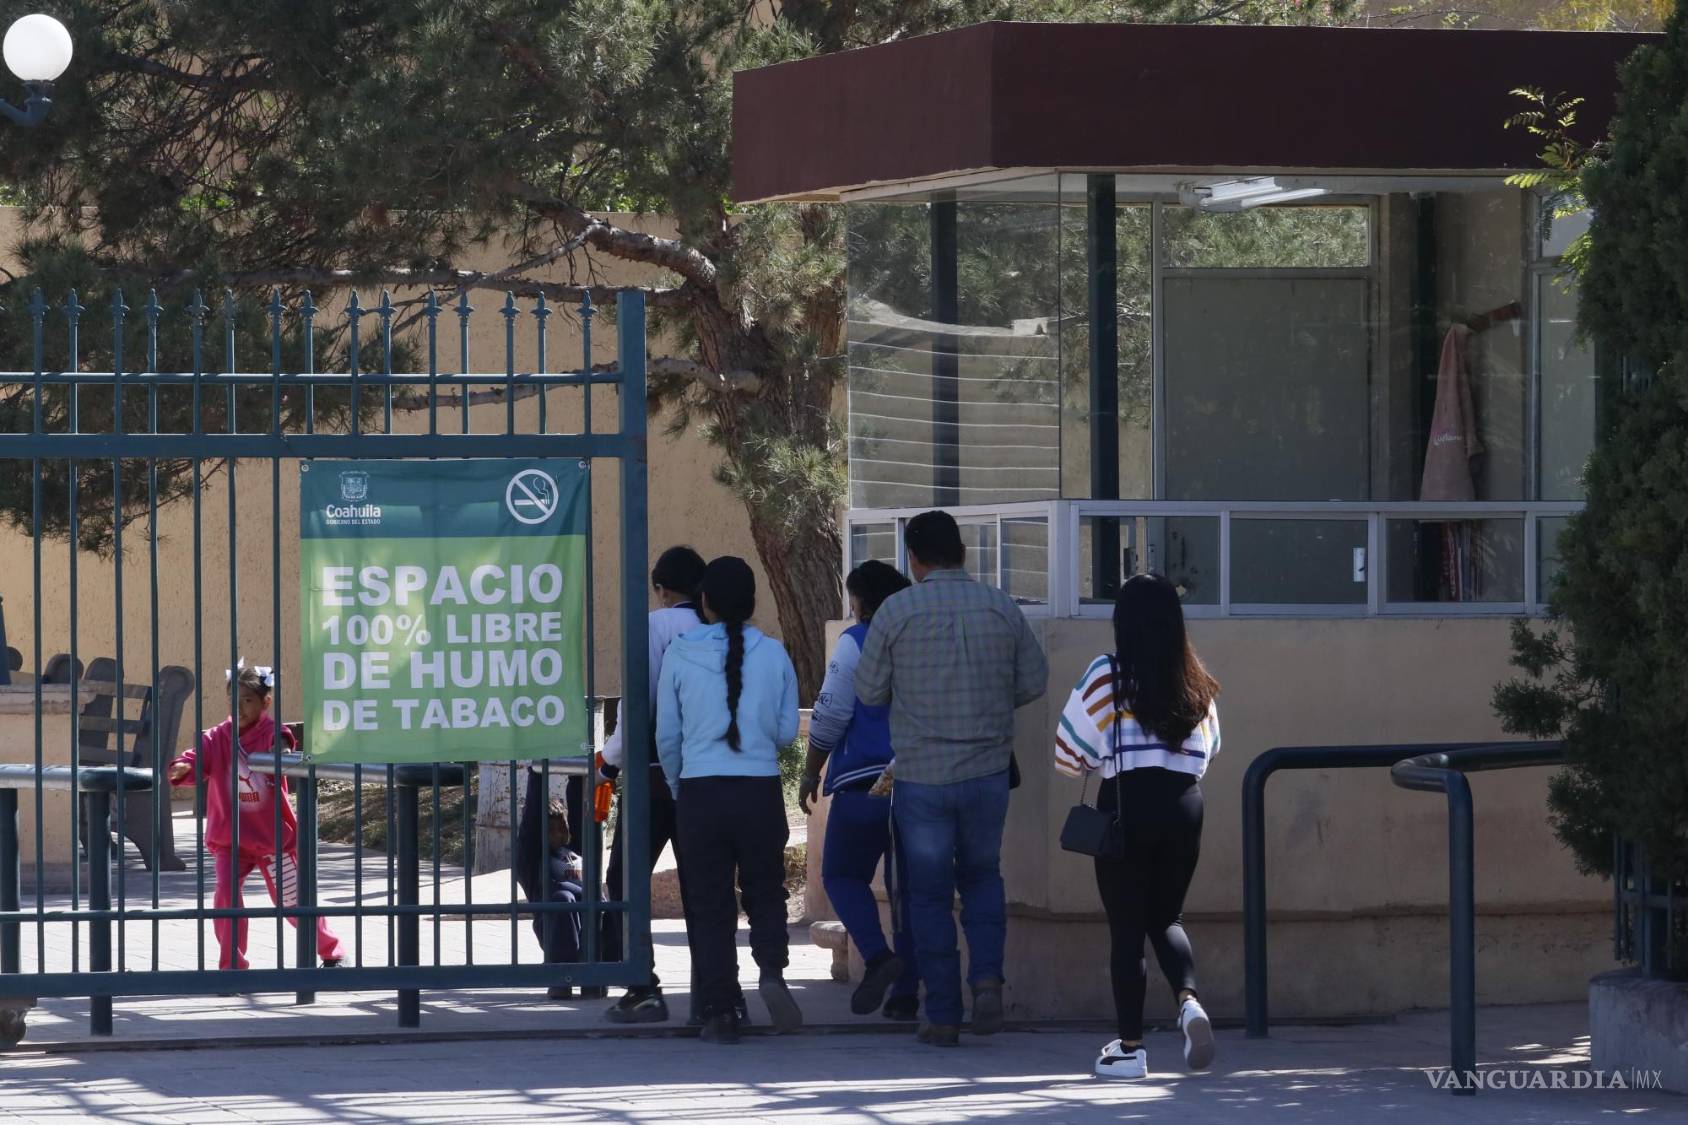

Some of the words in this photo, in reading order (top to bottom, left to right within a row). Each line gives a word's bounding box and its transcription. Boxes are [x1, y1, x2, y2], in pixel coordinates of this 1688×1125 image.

[326, 504, 382, 518] Coahuila
[322, 563, 563, 606] ESPACIO
[321, 613, 432, 646] 100%
[446, 611, 563, 644] LIBRE
[323, 652, 390, 690] DE
[410, 648, 563, 689] HUMO
[323, 699, 379, 731] DE
[392, 695, 565, 729] TABACO
